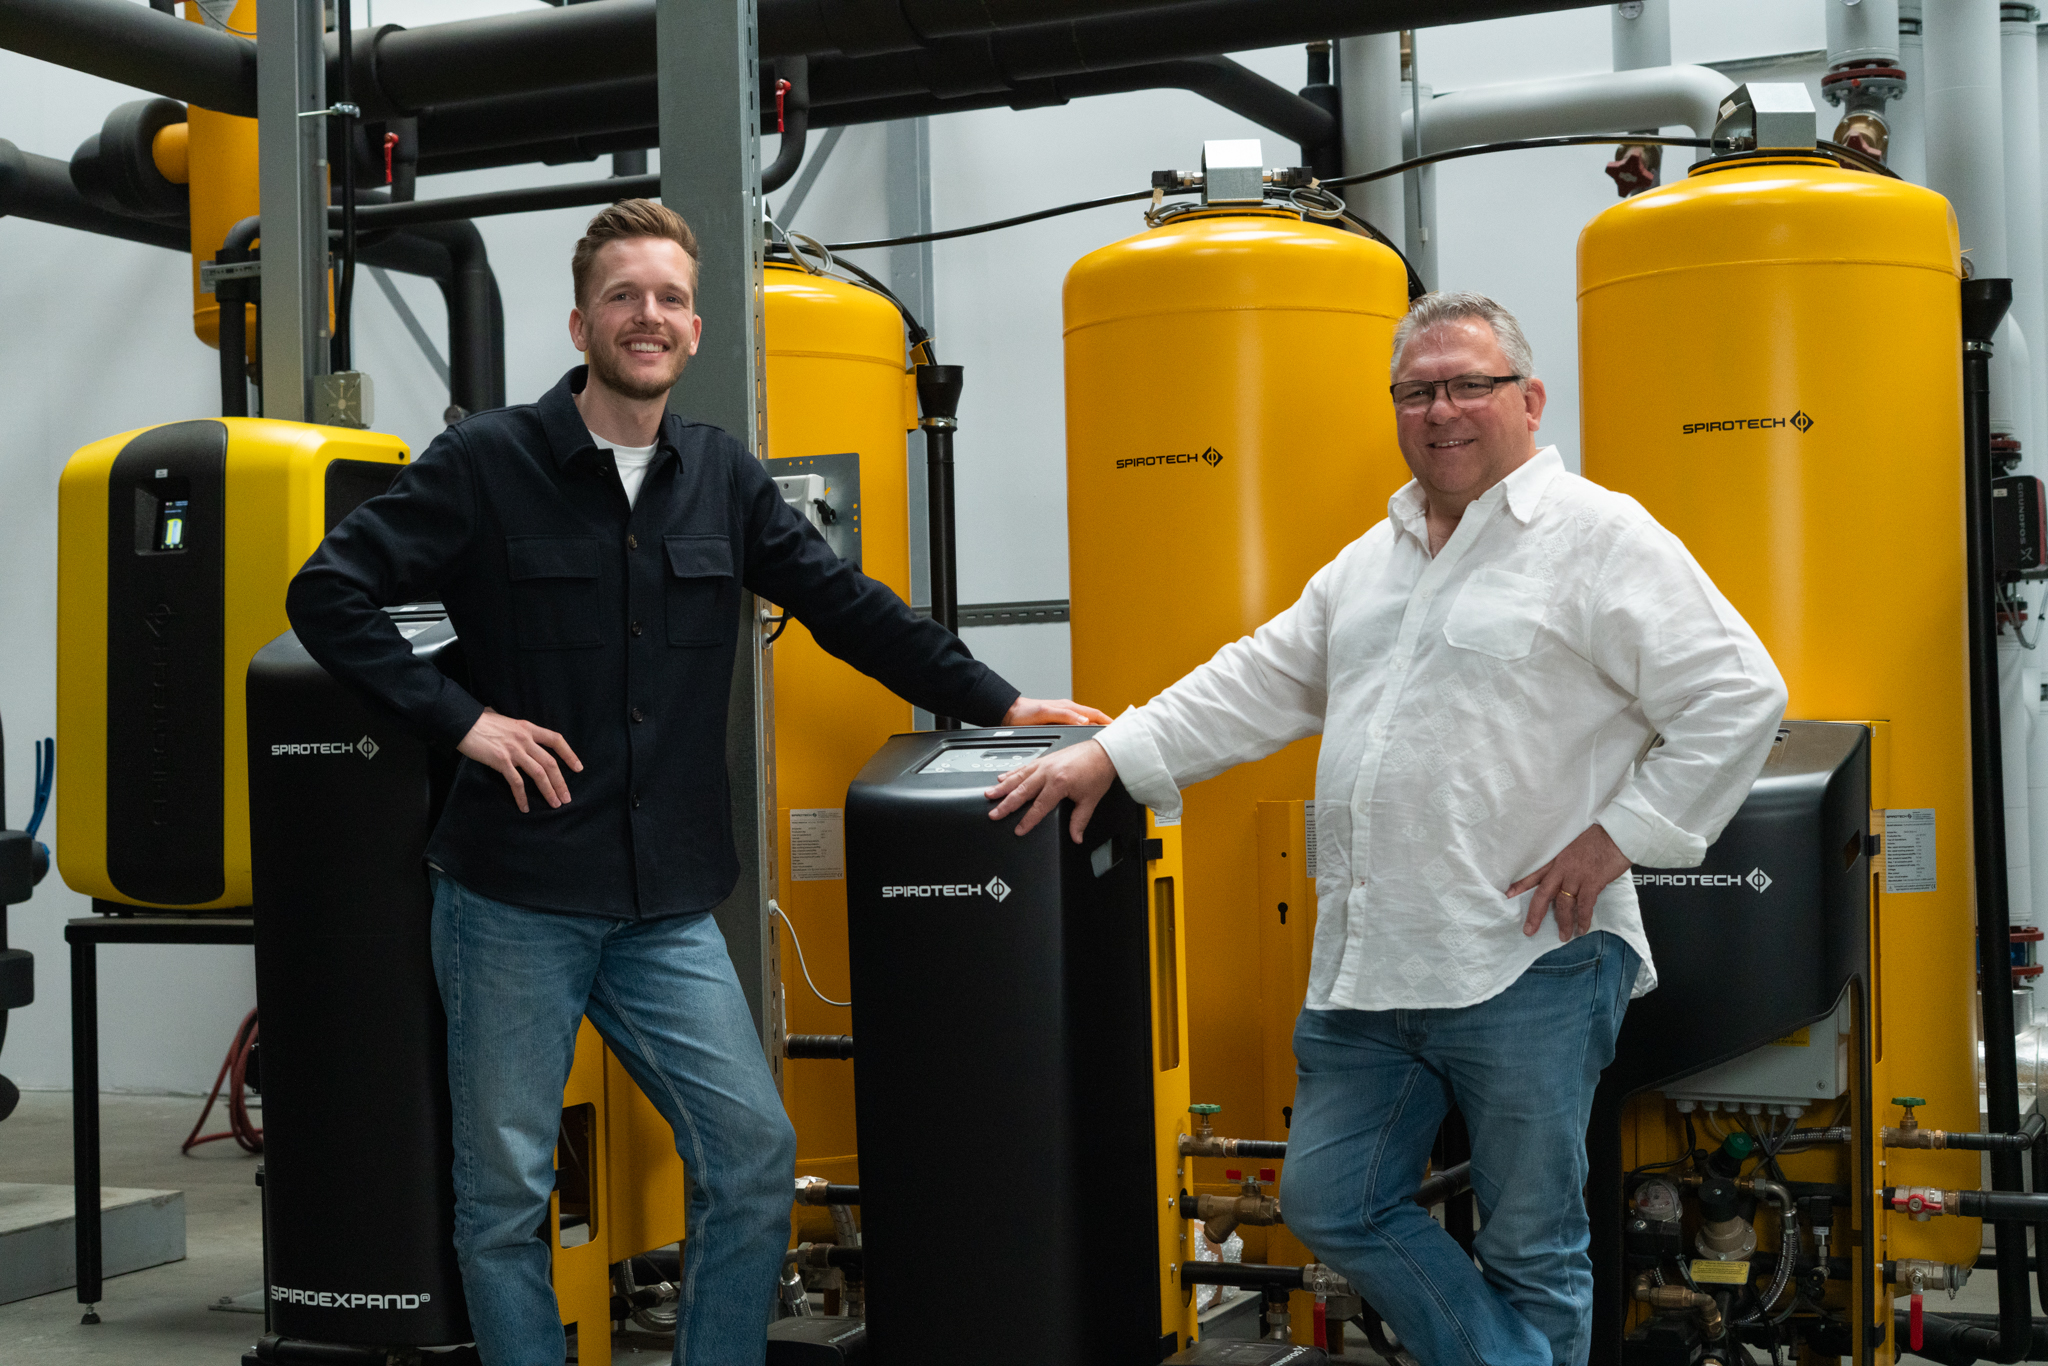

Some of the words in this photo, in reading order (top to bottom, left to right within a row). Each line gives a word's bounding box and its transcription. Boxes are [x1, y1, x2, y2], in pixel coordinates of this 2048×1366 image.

[1682, 416, 1786, 435] SPIROTECH
[1115, 453, 1199, 470] SPIROTECH
[2017, 482, 2027, 545] GRUNDFOS
[271, 742, 354, 756] SPIROTECH
[1632, 874, 1742, 887] SPIROTECH
[881, 883, 982, 899] SPIROTECH
